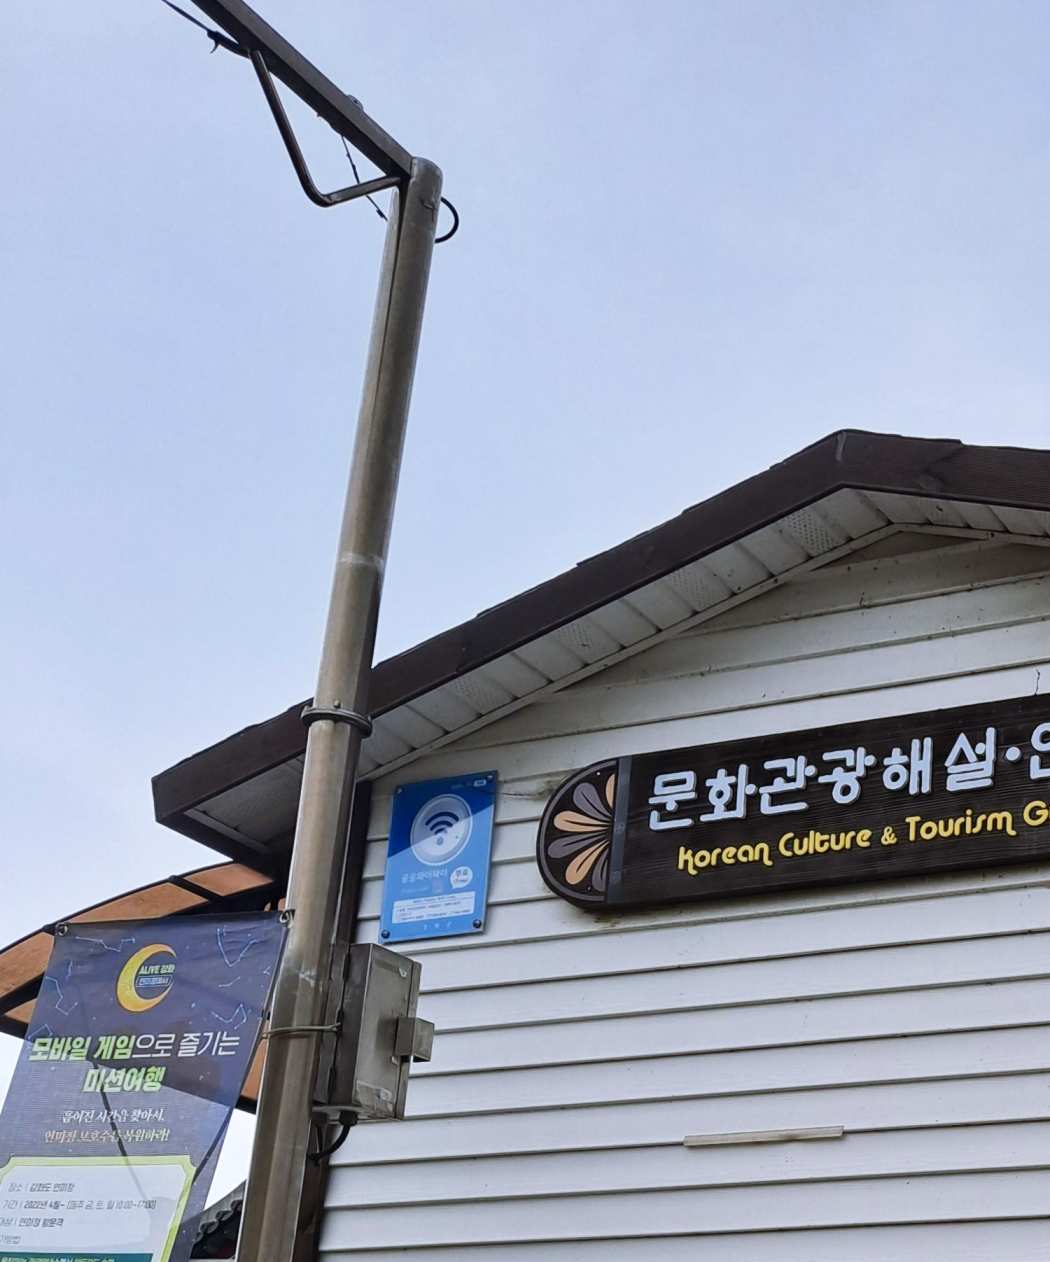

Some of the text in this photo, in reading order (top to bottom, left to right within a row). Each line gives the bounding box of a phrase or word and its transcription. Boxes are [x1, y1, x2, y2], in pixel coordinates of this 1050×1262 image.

[677, 841, 773, 876] Korean
[778, 828, 873, 858] Culture
[881, 826, 898, 846] &
[905, 809, 1017, 843] Tourism
[28, 1031, 240, 1062] 모바일 게임으로 즐기는
[82, 1066, 167, 1093] 미션여행
